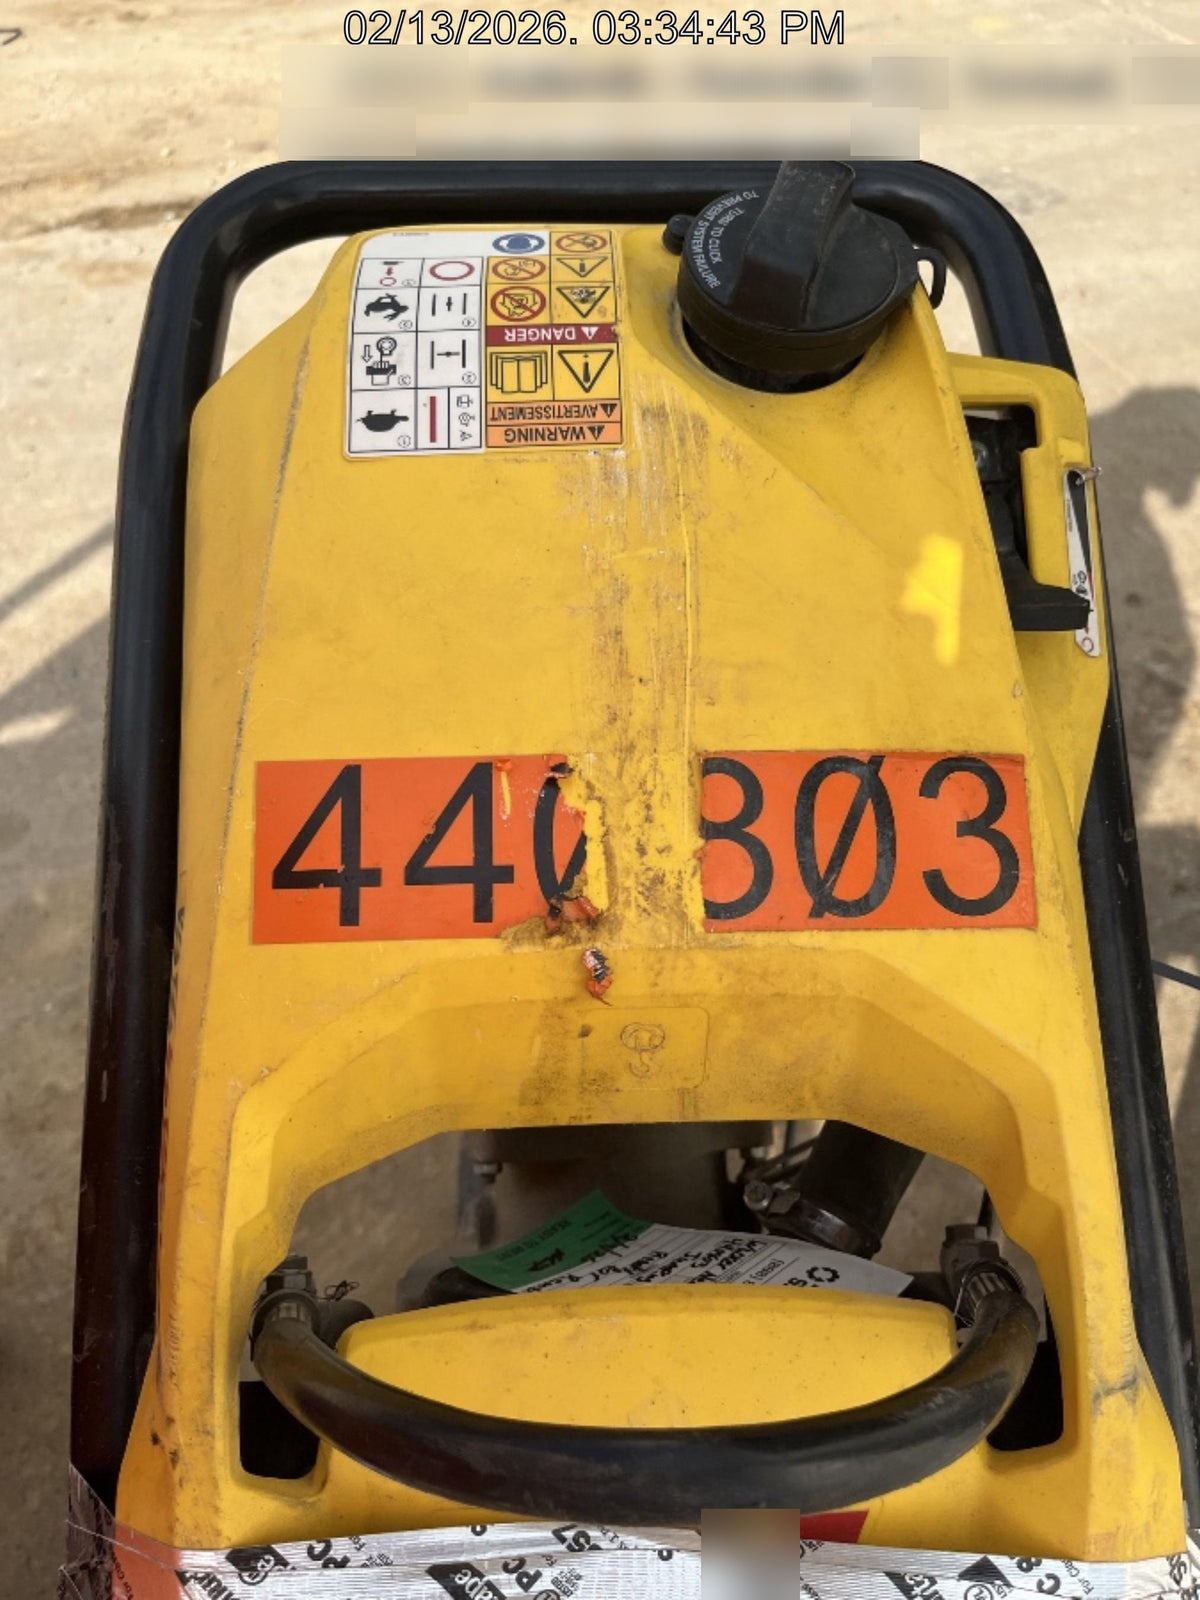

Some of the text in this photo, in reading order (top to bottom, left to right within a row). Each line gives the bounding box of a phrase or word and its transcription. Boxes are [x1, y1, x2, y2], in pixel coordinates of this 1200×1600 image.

[743, 190, 760, 200] TO
[692, 220, 710, 253] SYSTEM
[711, 226, 725, 237] TO
[709, 238, 722, 263] CLICK
[693, 253, 721, 288] FAILURE
[504, 328, 577, 342] DANGER
[490, 404, 598, 421] AVERTISSEMENT
[504, 427, 585, 443] WARNING
